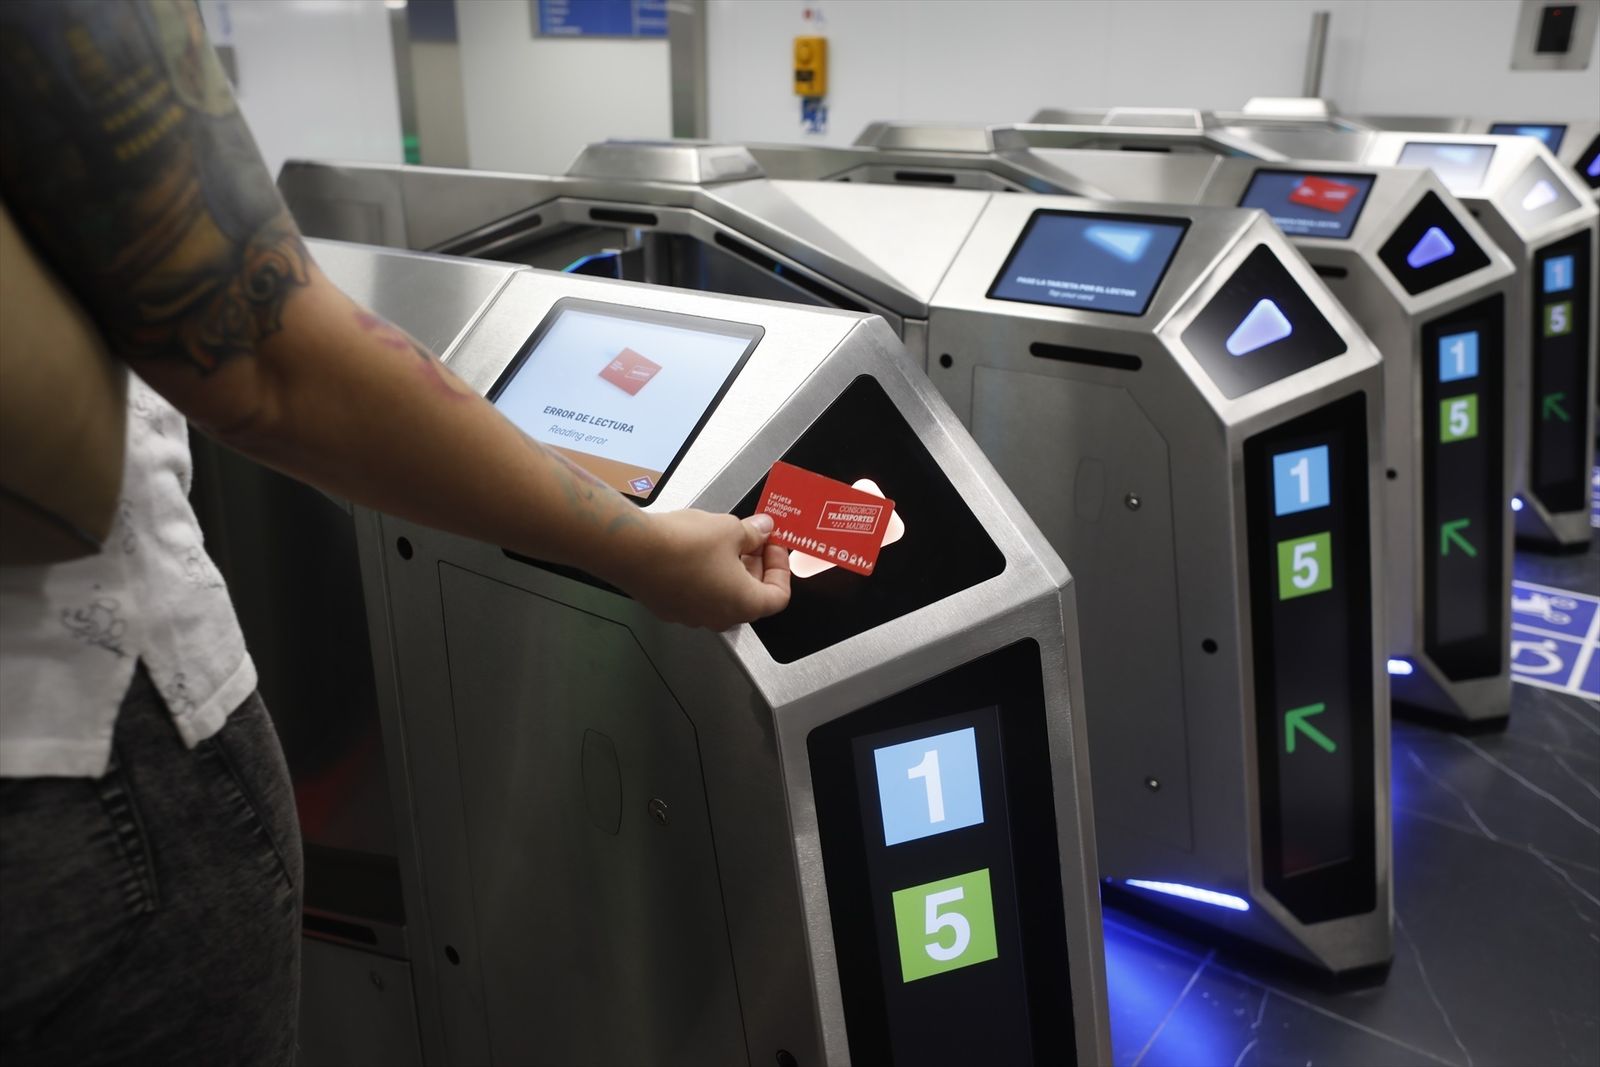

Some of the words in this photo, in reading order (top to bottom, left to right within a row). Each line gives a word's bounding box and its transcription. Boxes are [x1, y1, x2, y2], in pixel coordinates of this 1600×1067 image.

[1552, 264, 1565, 289] 1
[1551, 304, 1567, 333] 5
[1450, 339, 1465, 374] 1
[543, 405, 576, 420] ERROR
[575, 413, 590, 423] DE
[589, 416, 635, 434] LECTURA
[1449, 400, 1469, 436] 5
[548, 424, 585, 442] Reading
[584, 434, 609, 446] error
[1290, 457, 1309, 504] 1
[767, 498, 802, 516] transporte
[769, 492, 792, 505] tarjeta
[839, 505, 878, 515] CONSORCIO
[827, 512, 875, 523] TRANSPORTES
[846, 522, 872, 531] MADRID
[1292, 541, 1319, 589] 5
[907, 749, 945, 824] 1
[924, 886, 971, 961] 5
